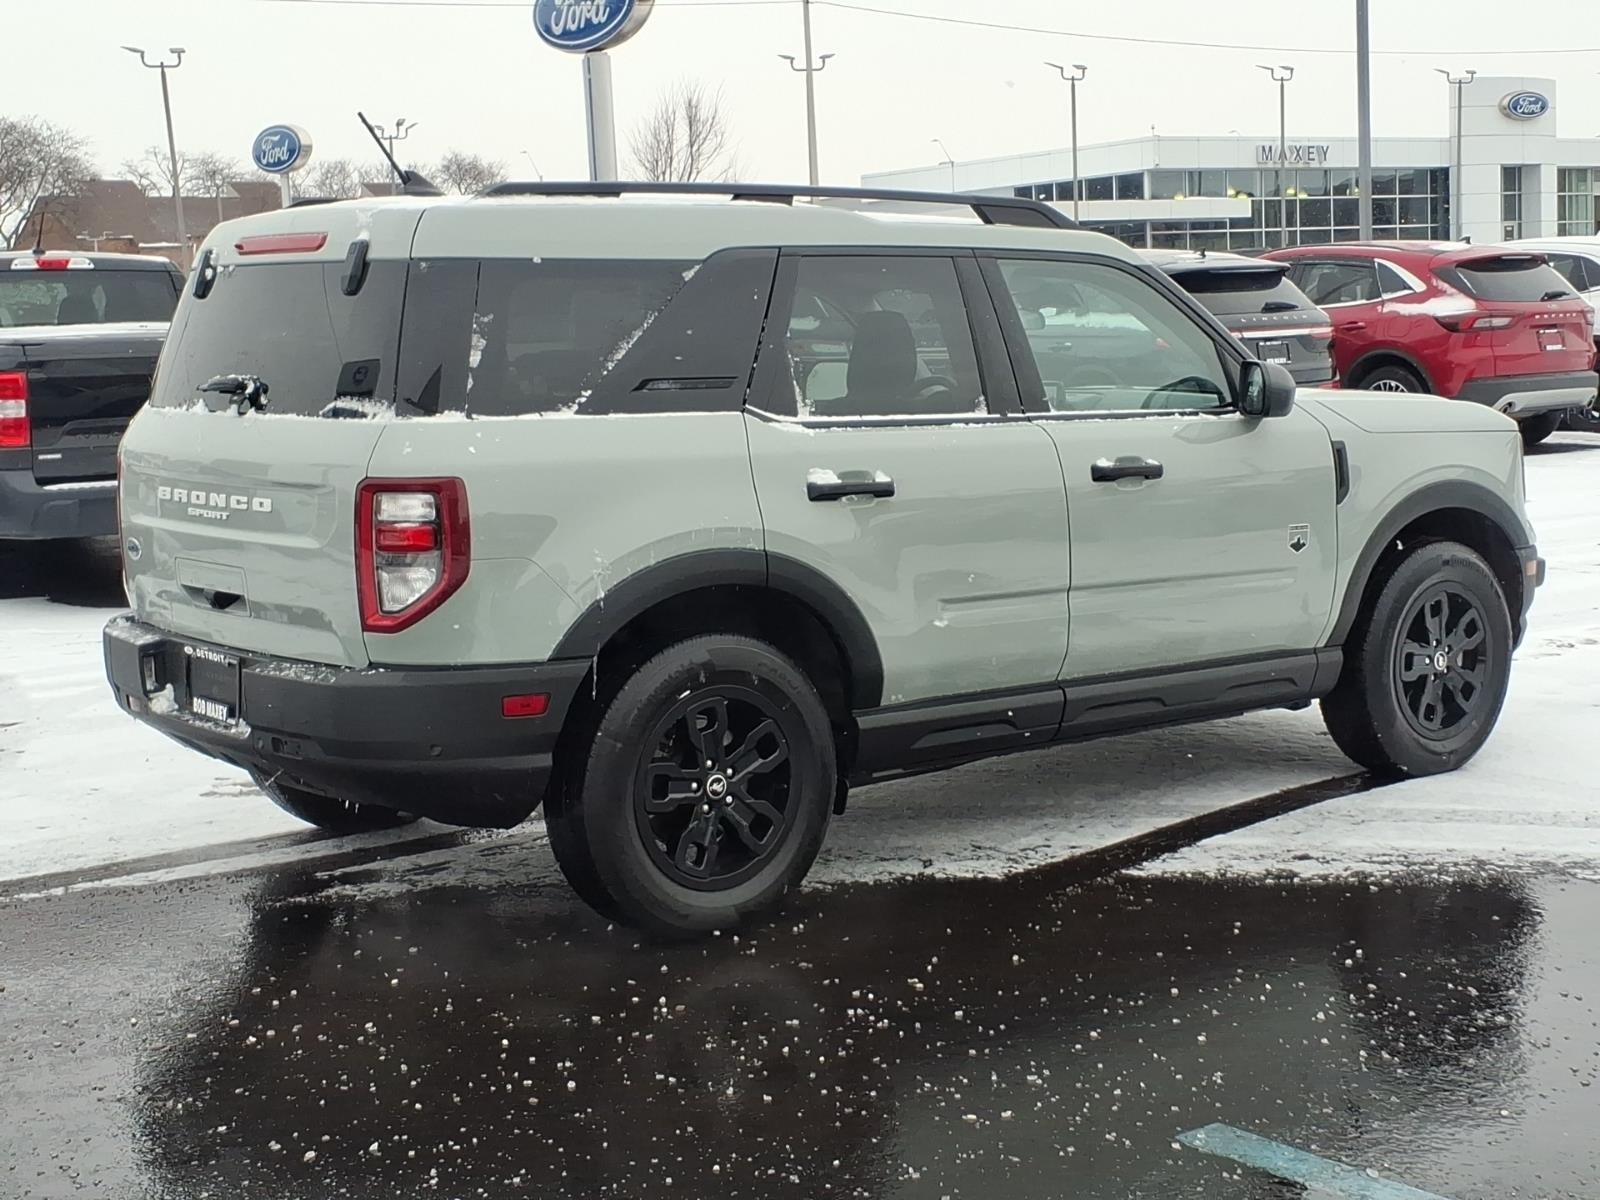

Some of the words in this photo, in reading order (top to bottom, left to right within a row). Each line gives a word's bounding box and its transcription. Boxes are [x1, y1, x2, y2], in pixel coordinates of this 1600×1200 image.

[551, 0, 609, 35] Ford
[1517, 97, 1542, 112] Ford
[261, 135, 289, 165] Ford
[1261, 145, 1329, 161] MAXEY
[158, 486, 272, 512] BRONCO
[187, 507, 230, 520] SPORT
[196, 648, 225, 663] DETROIT
[193, 697, 206, 715] BOB
